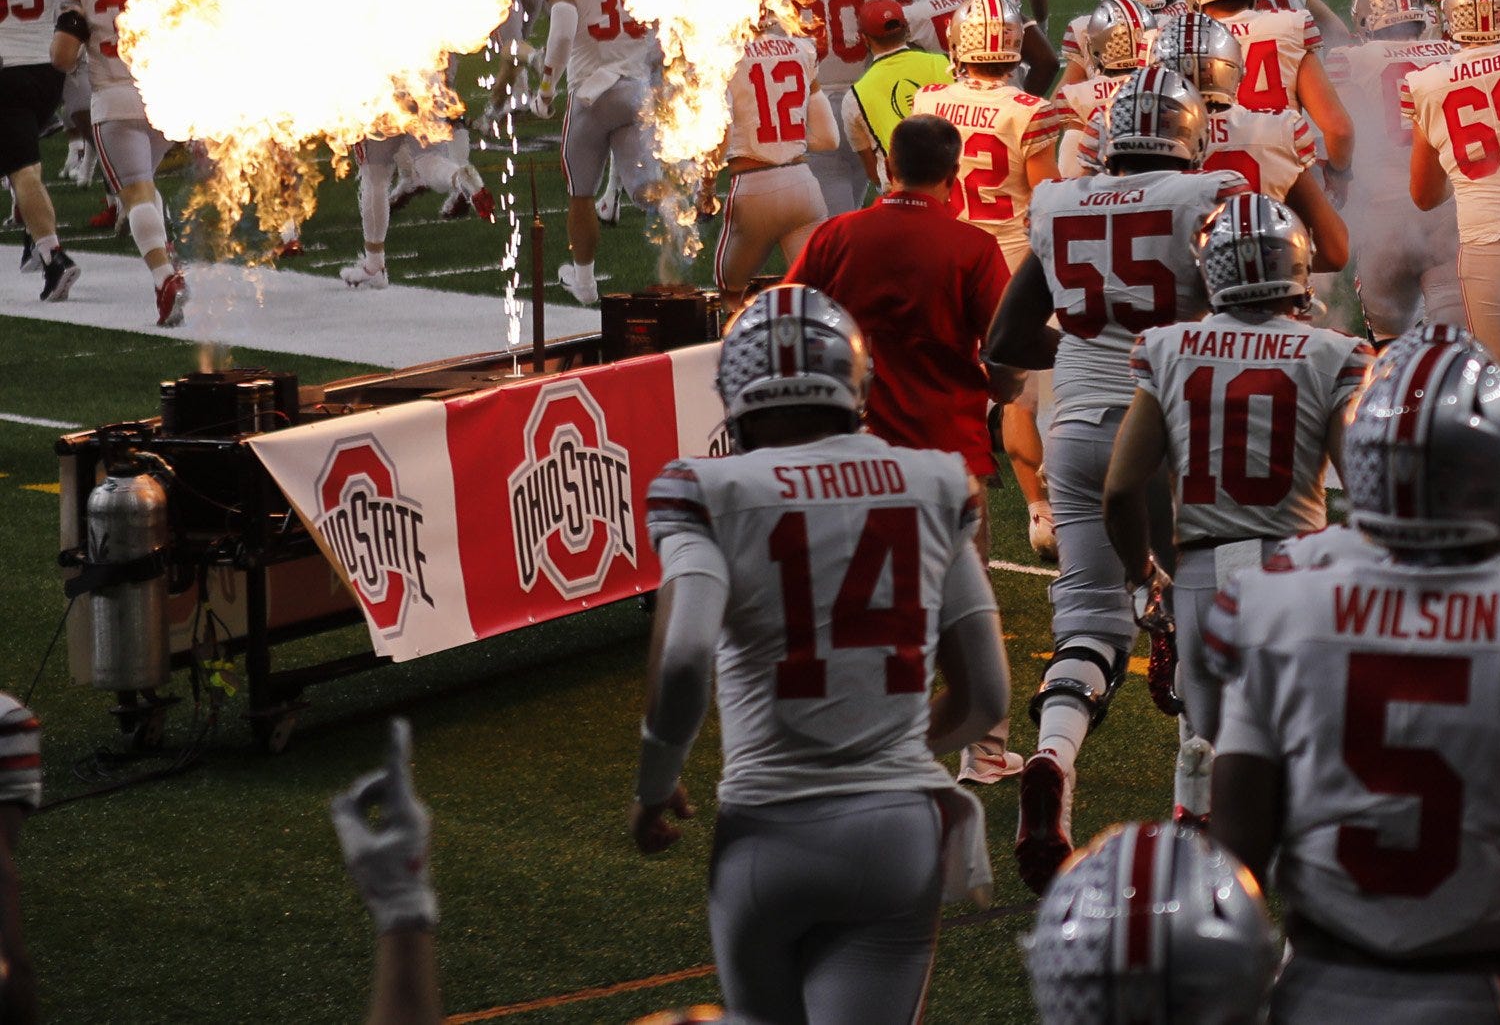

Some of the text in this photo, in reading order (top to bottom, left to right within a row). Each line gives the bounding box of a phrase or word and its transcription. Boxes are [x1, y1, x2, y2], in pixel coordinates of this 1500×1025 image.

[1383, 12, 1425, 25] EQUALITY
[970, 54, 1016, 62] EQUALITY
[748, 60, 806, 143] 12
[936, 103, 1000, 129] WIGLUSZ
[1113, 141, 1176, 152] EQUALITY
[1053, 210, 1177, 337] 55
[1222, 284, 1291, 303] EQUALITY
[1179, 329, 1310, 361] MARTINEZ
[742, 384, 837, 405] EQUALITY
[1182, 365, 1298, 507] 10
[773, 459, 906, 499] STROUD
[768, 506, 928, 700] 14
[1333, 585, 1499, 643] WILSON
[1334, 651, 1472, 900] 5
